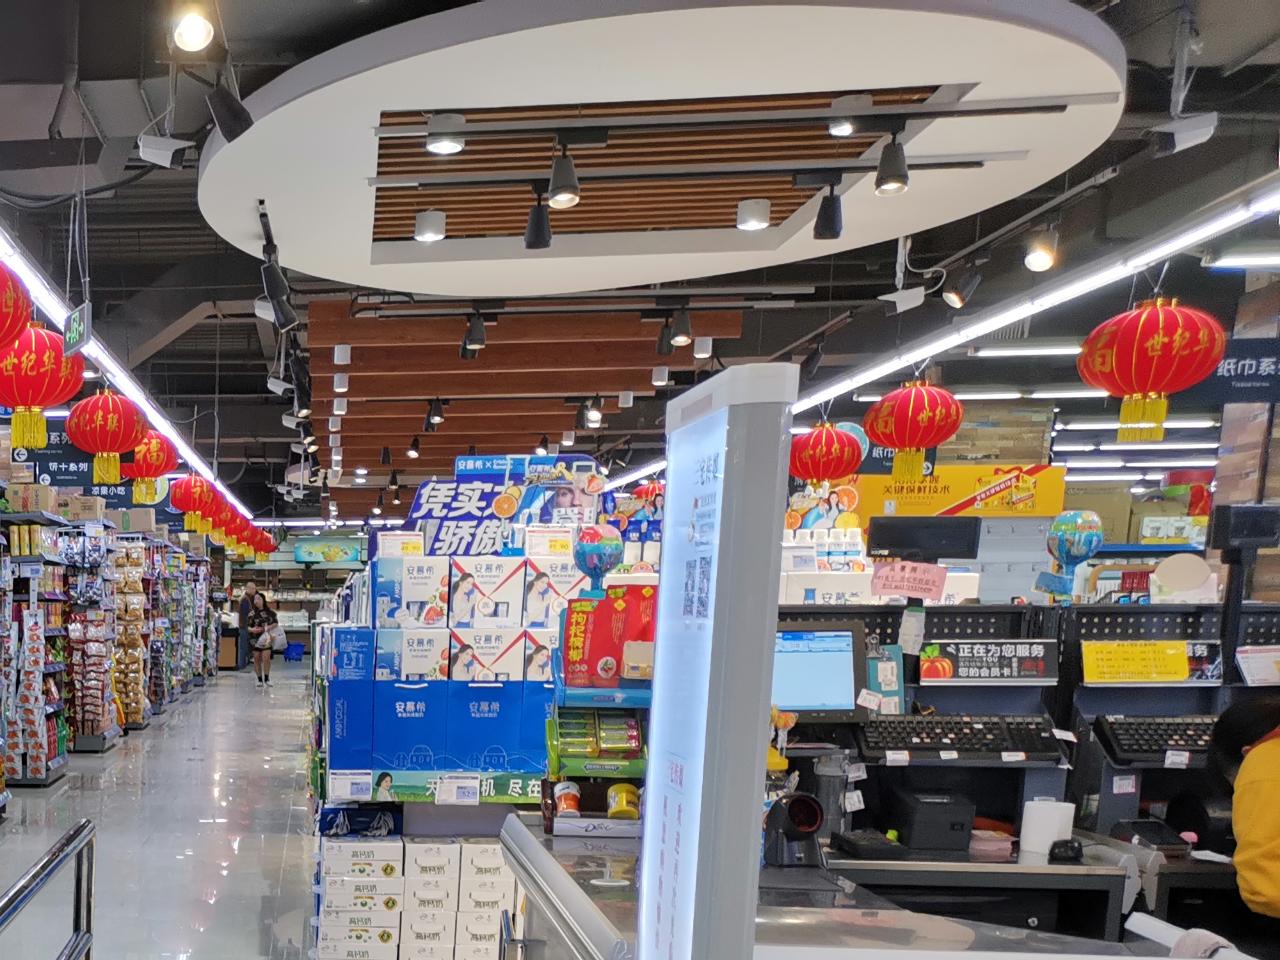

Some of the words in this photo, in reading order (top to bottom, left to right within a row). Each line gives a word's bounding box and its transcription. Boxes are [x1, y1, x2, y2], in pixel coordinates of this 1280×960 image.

[0, 350, 73, 378] 世纪华联
[1216, 357, 1280, 377] 纸巾系
[135, 437, 164, 464] 福
[415, 518, 504, 555] 骄傲
[958, 643, 1045, 657] 正在为您服务
[958, 667, 1012, 677] 您的会员卡
[395, 701, 426, 713] 安慕希
[469, 701, 500, 713] 安慕希
